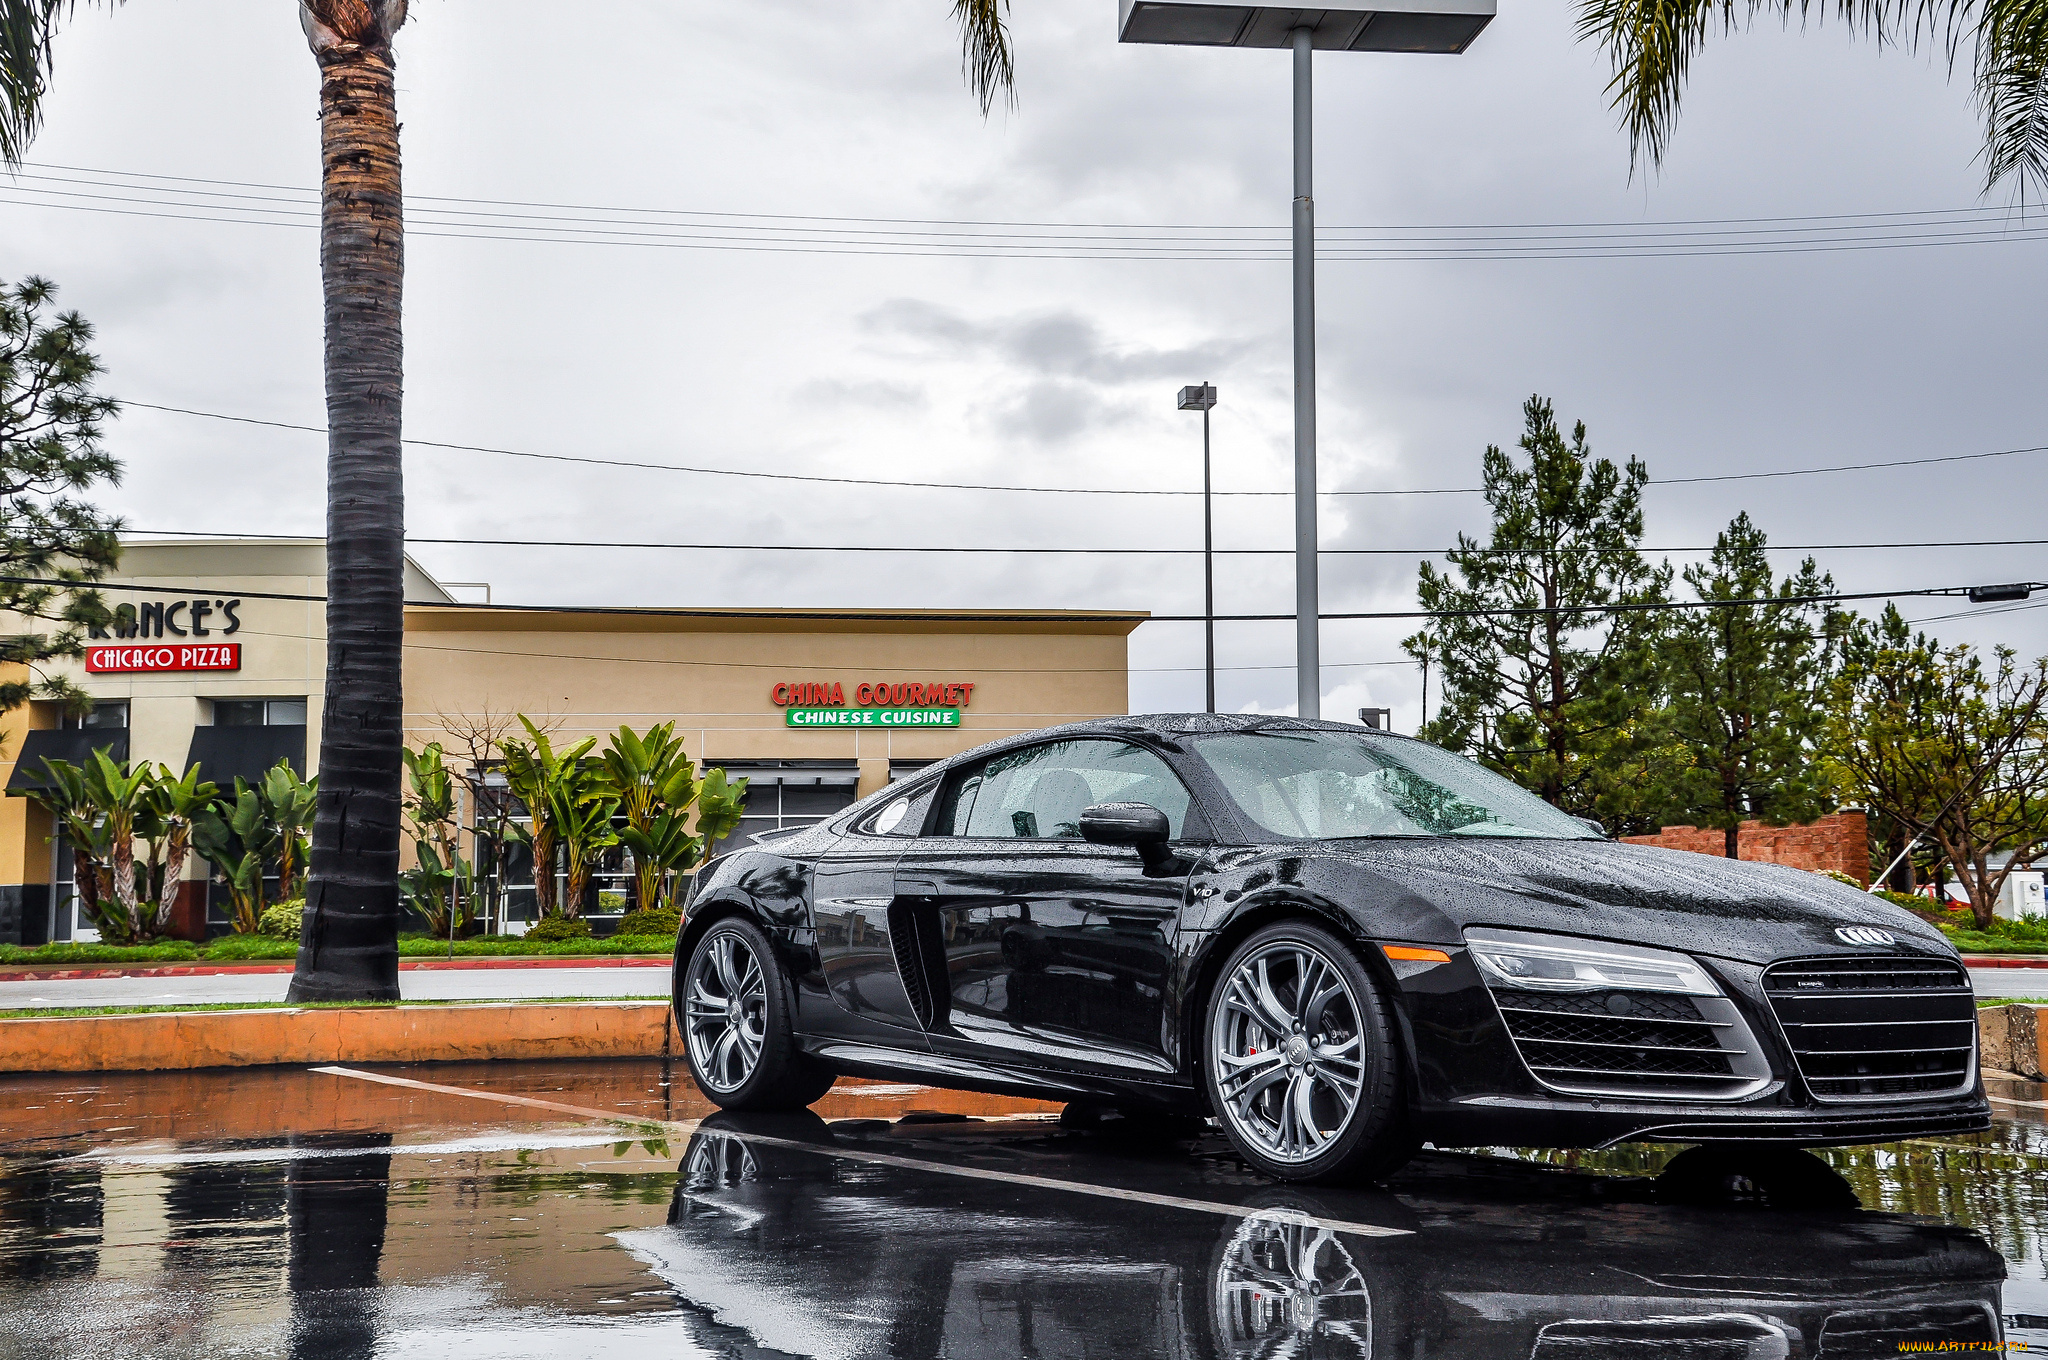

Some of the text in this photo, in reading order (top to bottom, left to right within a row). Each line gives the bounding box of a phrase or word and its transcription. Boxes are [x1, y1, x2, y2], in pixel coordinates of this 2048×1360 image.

[92, 647, 231, 668] CHICAGO PIZZA
[771, 681, 975, 707] CHINA GOURMET
[792, 711, 954, 724] CHINESE CUISINE
[1193, 887, 1213, 897] V10
